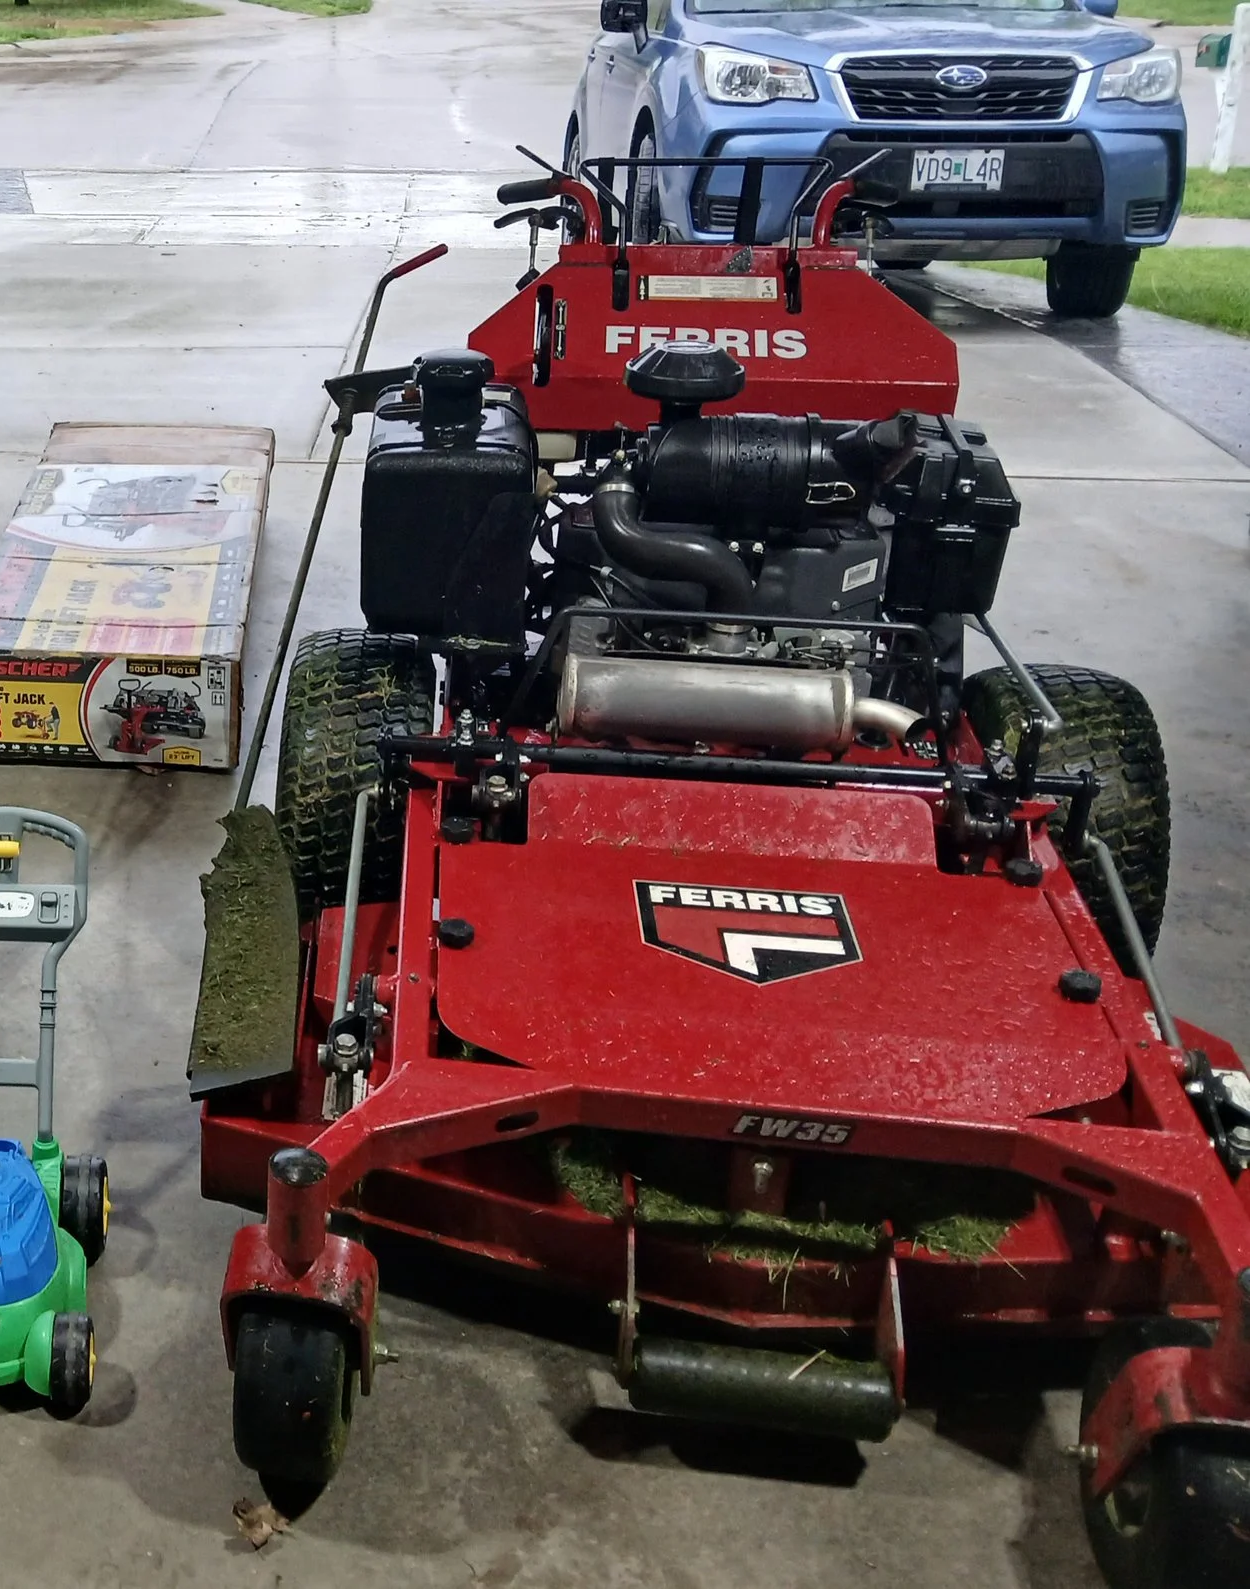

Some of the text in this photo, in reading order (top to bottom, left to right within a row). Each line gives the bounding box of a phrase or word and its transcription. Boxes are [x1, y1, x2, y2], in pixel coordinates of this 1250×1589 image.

[916, 157, 1002, 182] VD9 L4R
[13, 693, 46, 705] JACK
[648, 885, 834, 916] FERRIS
[733, 1115, 852, 1144] FW35
